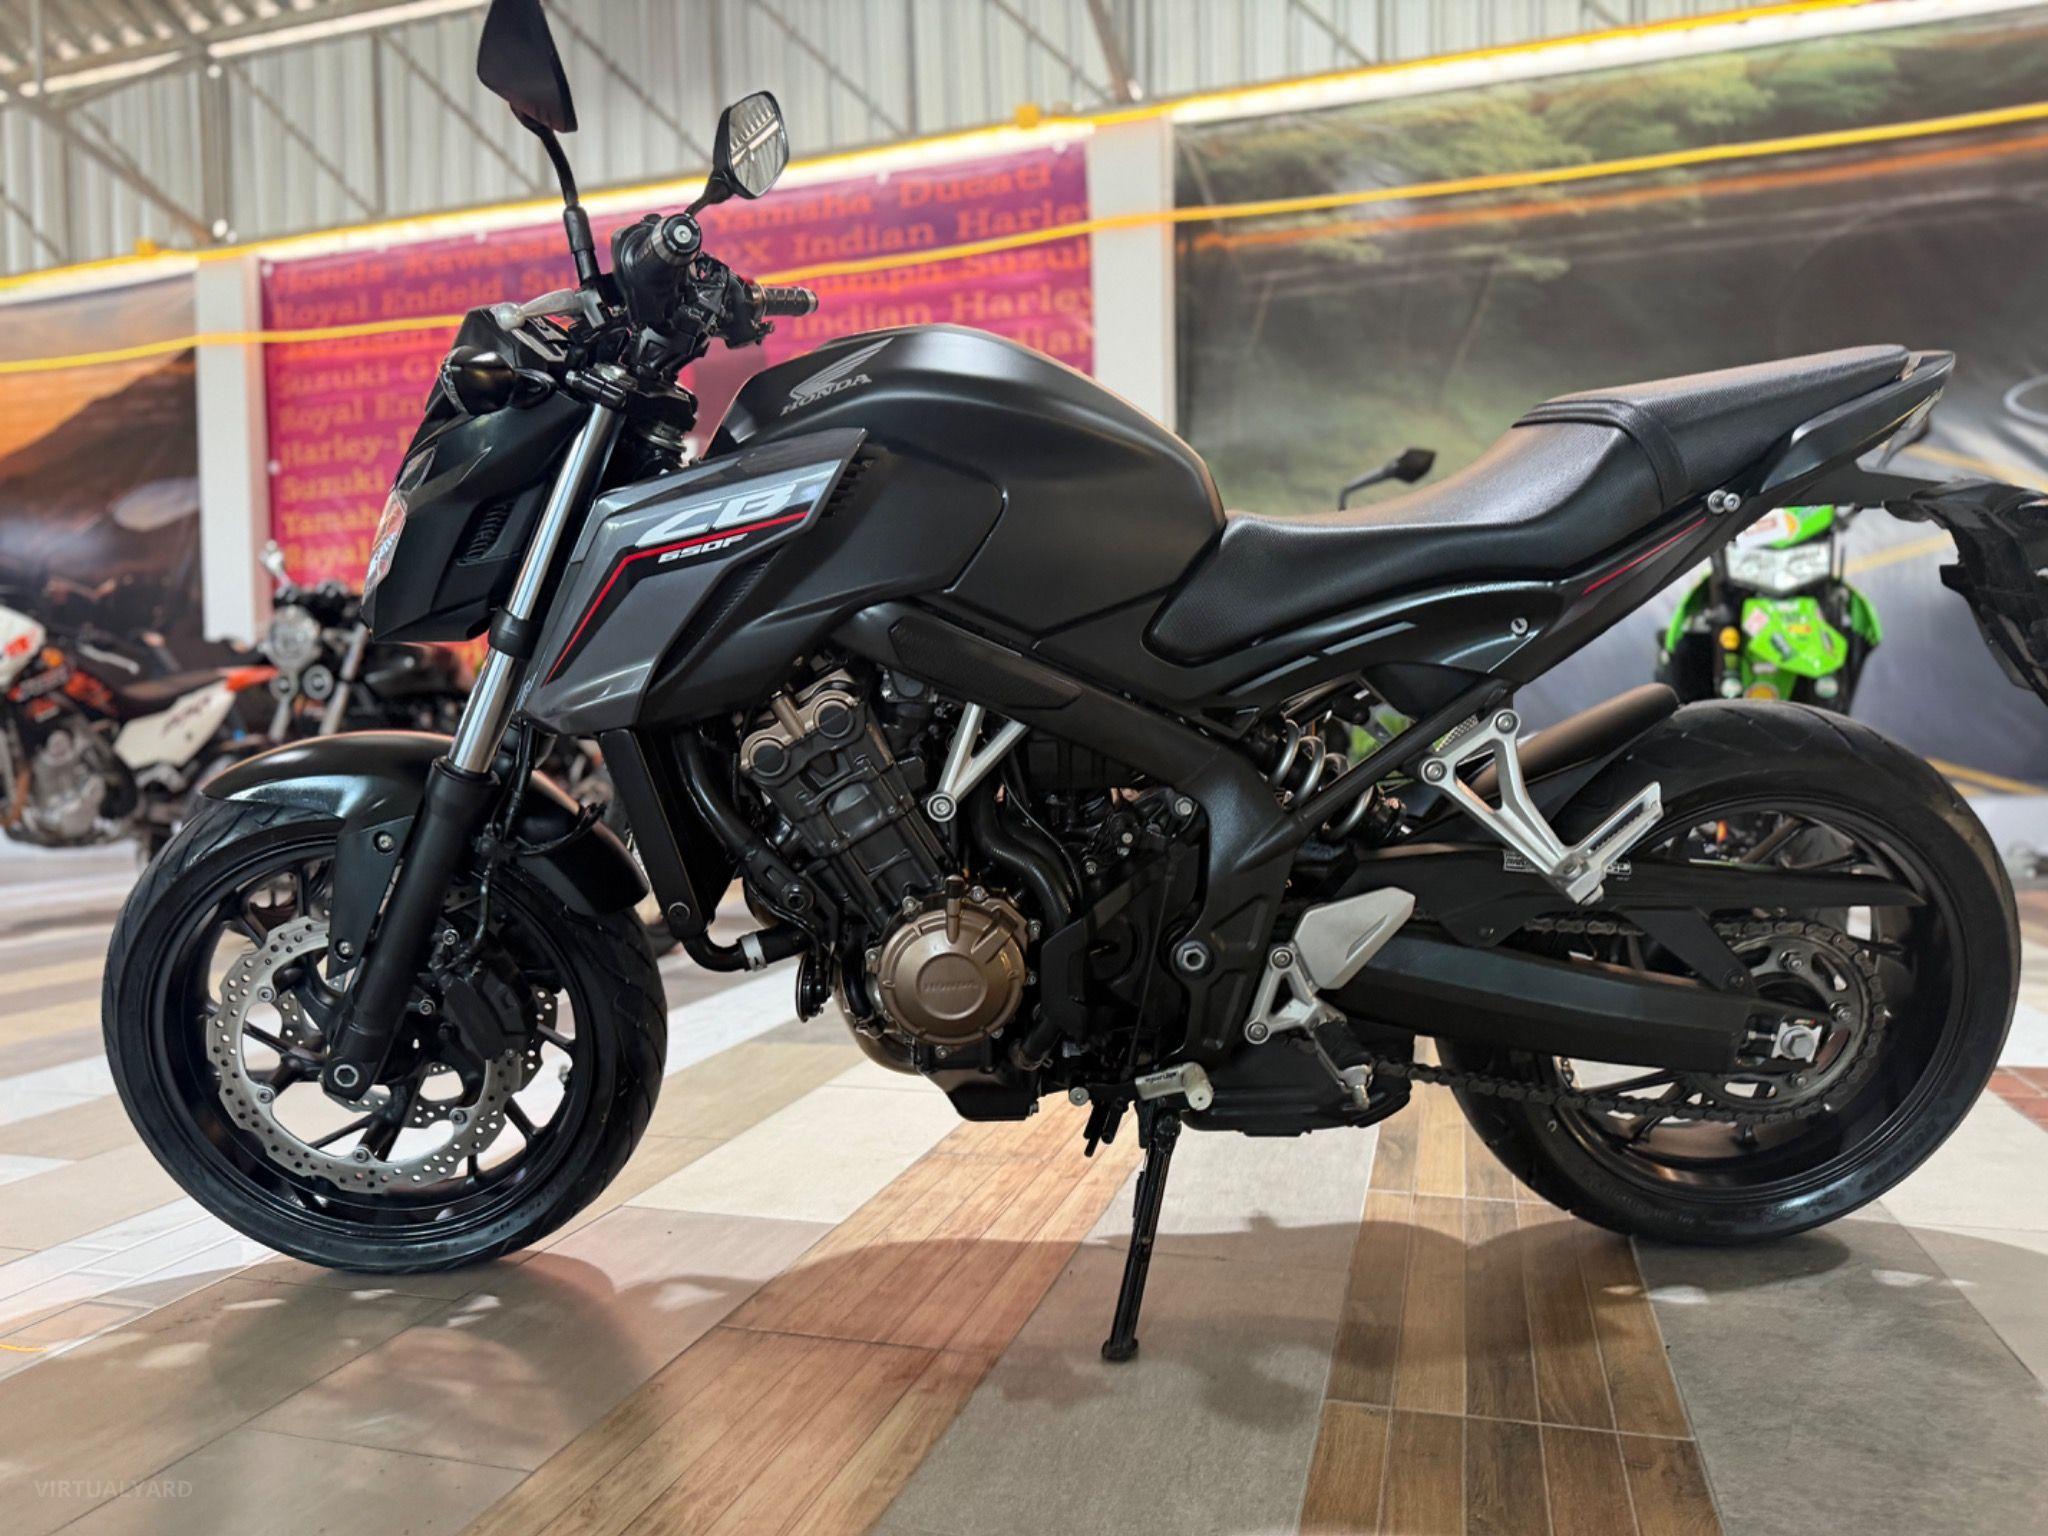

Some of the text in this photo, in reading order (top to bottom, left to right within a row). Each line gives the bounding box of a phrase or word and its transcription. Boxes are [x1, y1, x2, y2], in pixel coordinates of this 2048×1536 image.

[711, 190, 874, 234] Yamaha
[901, 161, 1051, 208] Ducati
[273, 291, 369, 331] Royal
[380, 271, 503, 315] Enfield
[792, 222, 937, 264] Indian
[277, 361, 389, 397] Suzuki
[793, 300, 934, 339] Indian
[279, 394, 363, 435] Royal
[780, 373, 872, 416] HONDA
[284, 465, 385, 502] Suzuki
[284, 503, 380, 537] Yamah
[635, 482, 797, 549] CB
[658, 532, 748, 564] 650F
